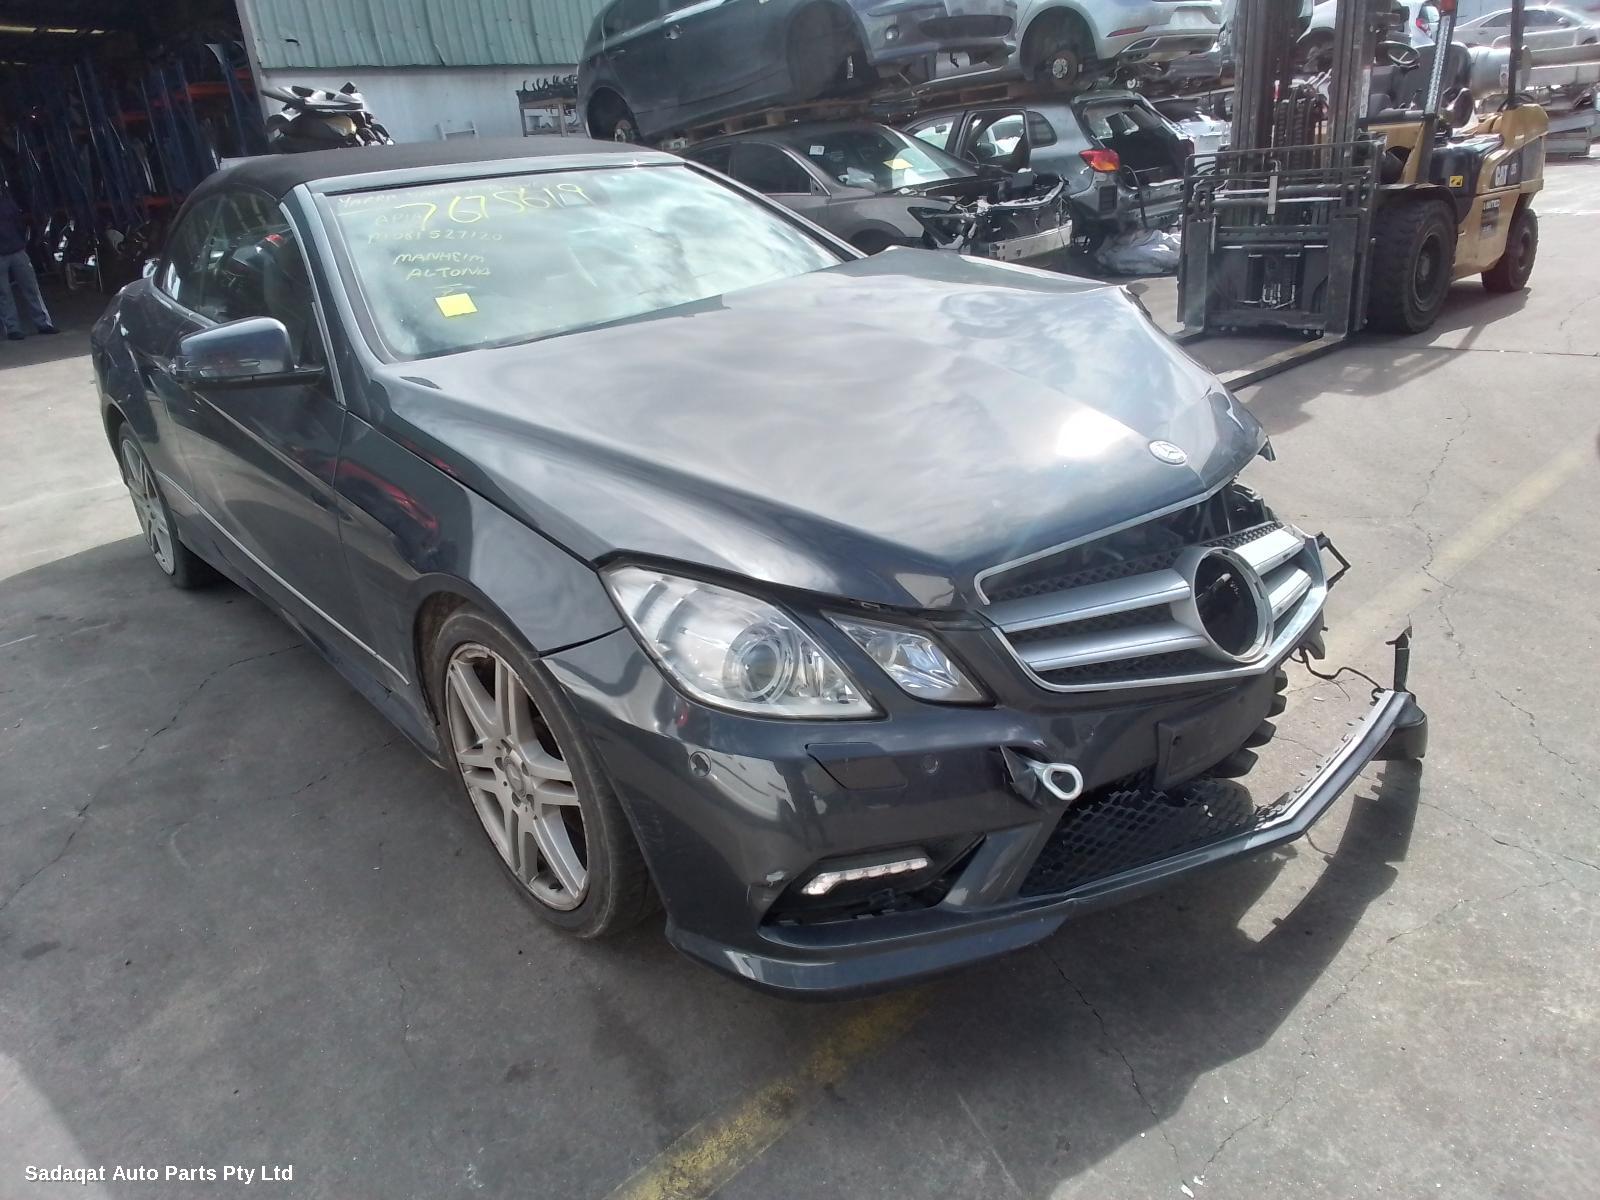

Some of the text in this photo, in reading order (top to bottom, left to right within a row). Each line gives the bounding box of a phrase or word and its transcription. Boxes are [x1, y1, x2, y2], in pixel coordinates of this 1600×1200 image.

[1495, 164, 1508, 187] CAT
[393, 250, 485, 265] MANHEIM
[406, 266, 492, 280] ALTONA
